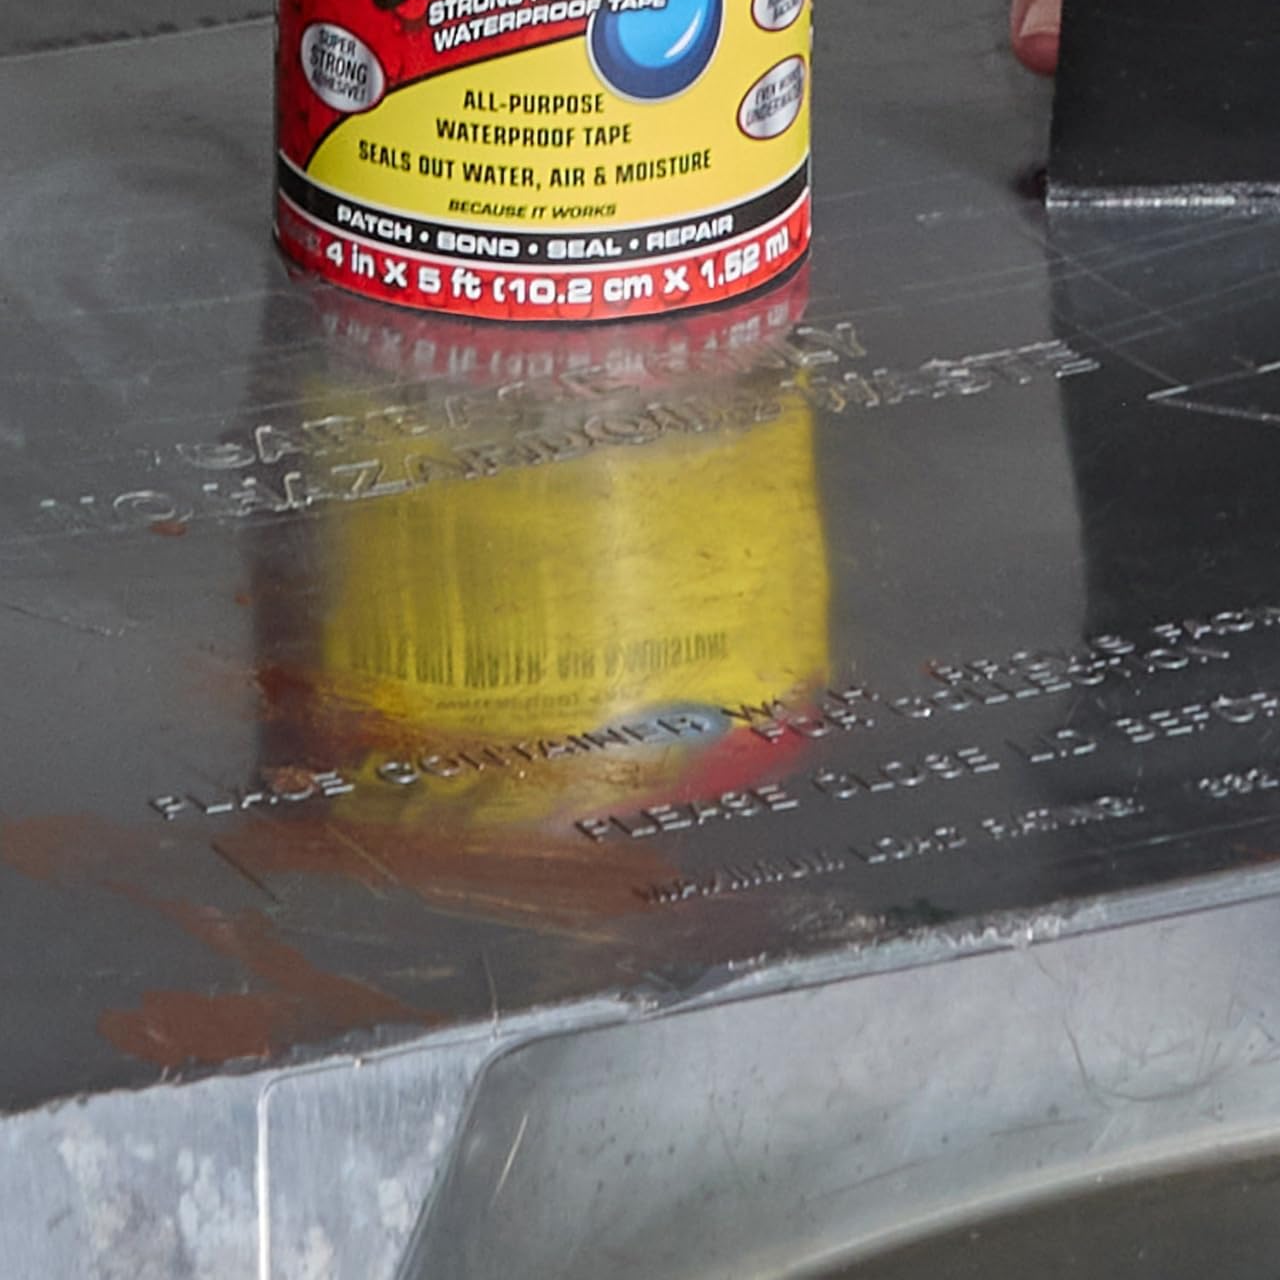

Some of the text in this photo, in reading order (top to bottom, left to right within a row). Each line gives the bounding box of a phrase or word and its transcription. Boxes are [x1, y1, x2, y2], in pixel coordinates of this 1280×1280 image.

[310, 44, 368, 86] STRONG
[463, 90, 605, 114] ALL-PURPOSE
[436, 118, 632, 147] WATERPROOF TAPE
[358, 139, 712, 190] SEALS OUT WATER, AIR & MOISTURE
[337, 204, 413, 243] PATCH
[437, 230, 520, 258] BOND
[547, 238, 622, 260] SEAL
[646, 214, 734, 251] REPAIR
[448, 198, 617, 219] BECAUSE IT WORKS
[326, 241, 344, 268] 4
[351, 244, 375, 279] in
[383, 257, 408, 289] X
[418, 266, 441, 294] 5
[451, 267, 482, 301] ft
[493, 276, 593, 306] (10.2
[603, 273, 653, 303] cm
[662, 266, 690, 294] X
[701, 242, 761, 289] 1.52
[148, 771, 355, 820] PLACE
[574, 783, 798, 843] PLEASE
[812, 746, 1000, 800] CLOSE
